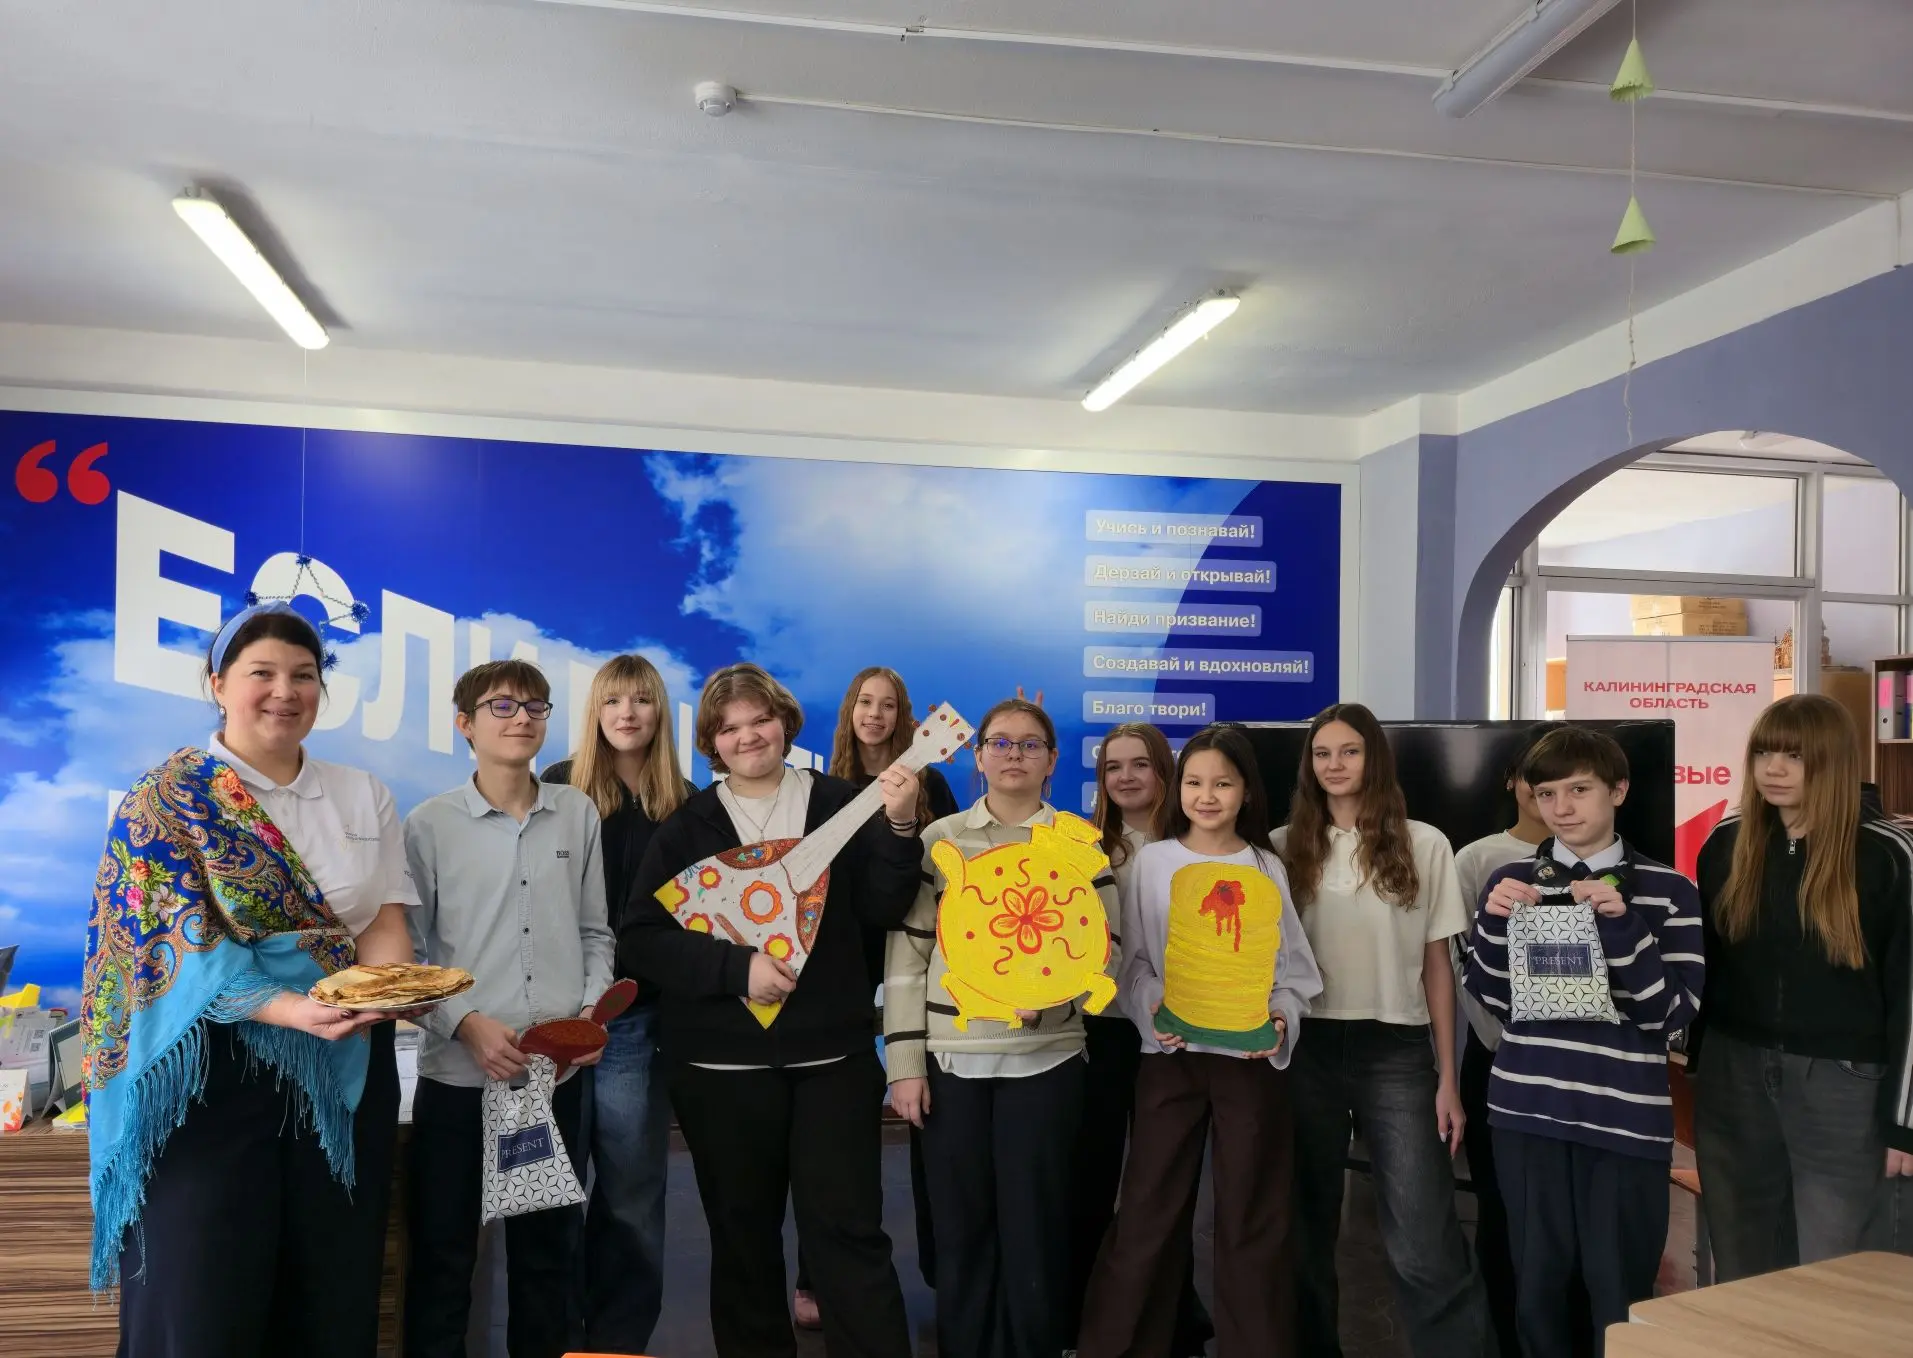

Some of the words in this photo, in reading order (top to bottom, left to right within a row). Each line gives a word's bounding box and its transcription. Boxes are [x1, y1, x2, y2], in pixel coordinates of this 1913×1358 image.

[1095, 518, 1147, 535] Учись
[1151, 525, 1162, 535] и
[1166, 523, 1256, 539] познавай!
[1094, 564, 1161, 582] Дерзай
[1166, 570, 1177, 580] и
[1181, 568, 1271, 585] открывай!
[1094, 610, 1150, 627] Найди
[1155, 612, 1256, 628] призвание!
[1093, 655, 1180, 672] Создавай
[1184, 660, 1195, 671] и
[1199, 659, 1309, 674] вдохновляй!
[1583, 681, 1757, 695] КАЛИНИНГРАДСКАЯ
[1092, 700, 1145, 715] Благо
[1150, 702, 1206, 718] твори!
[1629, 697, 1709, 709] ОБЛАСТЬ
[1673, 765, 1732, 786] вые
[1534, 955, 1585, 966] PRESENT
[501, 1137, 545, 1160] PRESENT
